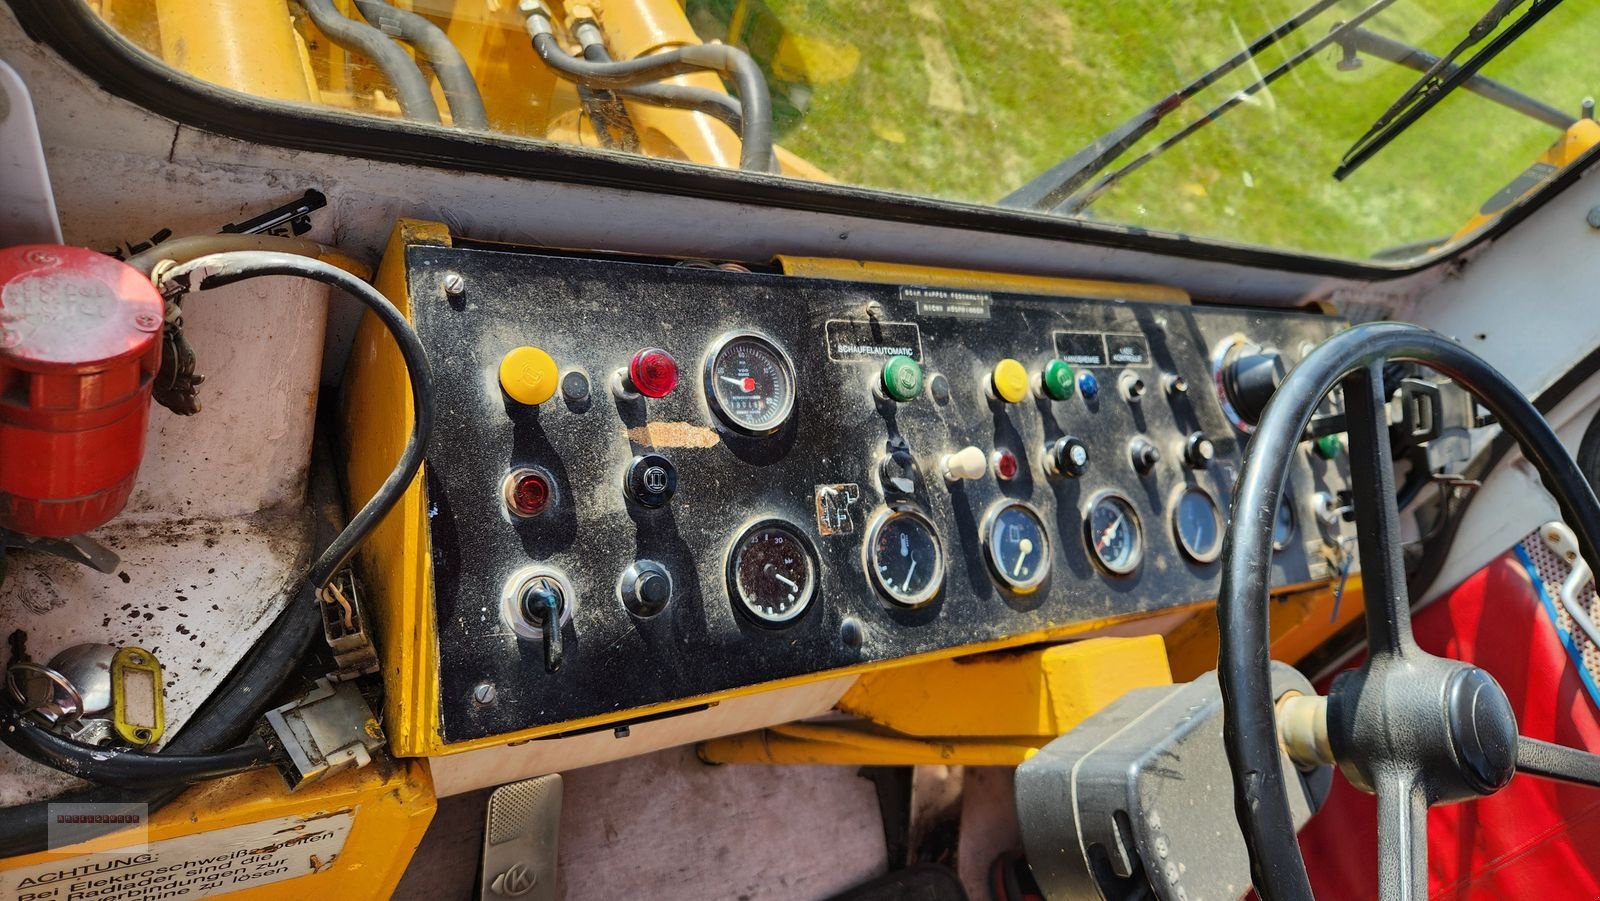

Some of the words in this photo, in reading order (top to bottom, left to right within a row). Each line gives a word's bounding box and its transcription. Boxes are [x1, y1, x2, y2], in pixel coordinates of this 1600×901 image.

[837, 344, 914, 357] SCHAUFELAUTOMATIC
[17, 853, 160, 888] ACHTUNG:
[18, 887, 58, 901] Bei
[70, 831, 334, 892] Elektroschweißabeiten
[67, 873, 176, 901] Radlader
[186, 859, 232, 876] sind
[241, 853, 274, 865] die
[199, 880, 224, 890] zu
[232, 866, 289, 883] lösen
[255, 858, 289, 870] zur
